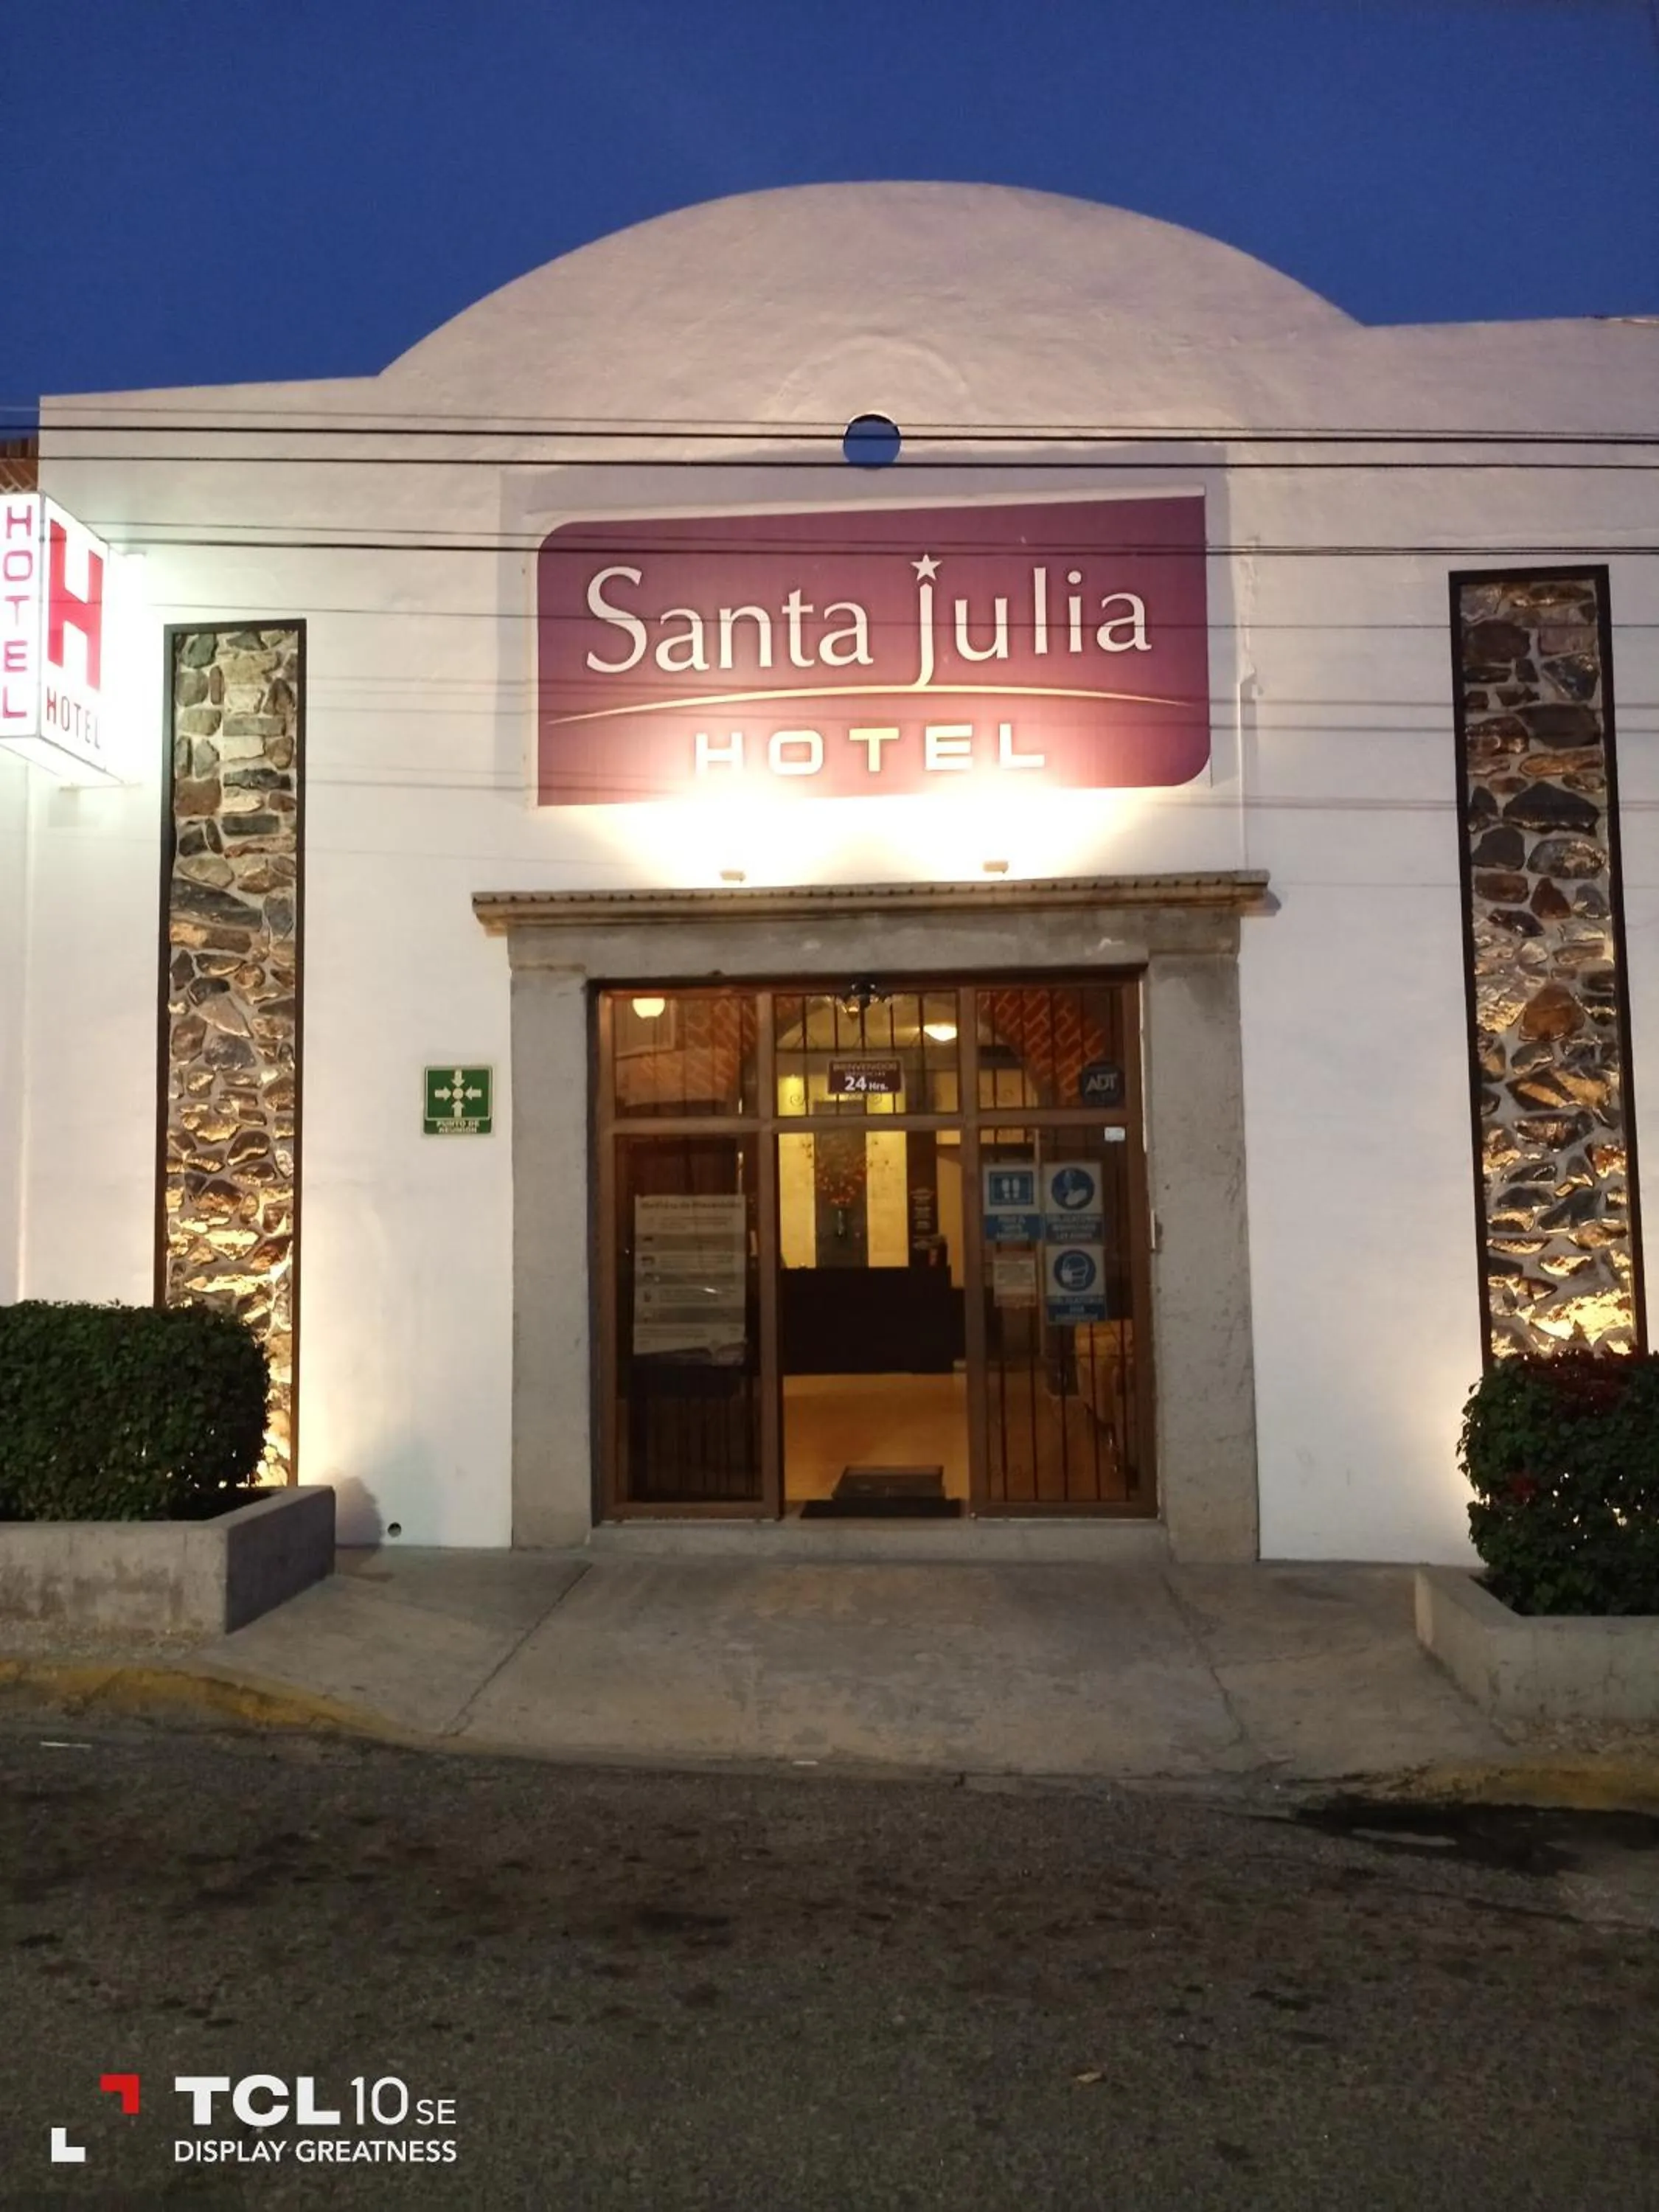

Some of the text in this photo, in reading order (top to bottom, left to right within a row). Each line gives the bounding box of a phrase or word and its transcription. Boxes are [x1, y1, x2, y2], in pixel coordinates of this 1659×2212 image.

[3, 505, 33, 718] HOTEL
[586, 566, 874, 674] Santa
[46, 686, 101, 750] HOTEL
[695, 723, 1045, 777] HOTEL
[844, 1076, 866, 1091] 24
[1085, 1072, 1118, 1093] ADT
